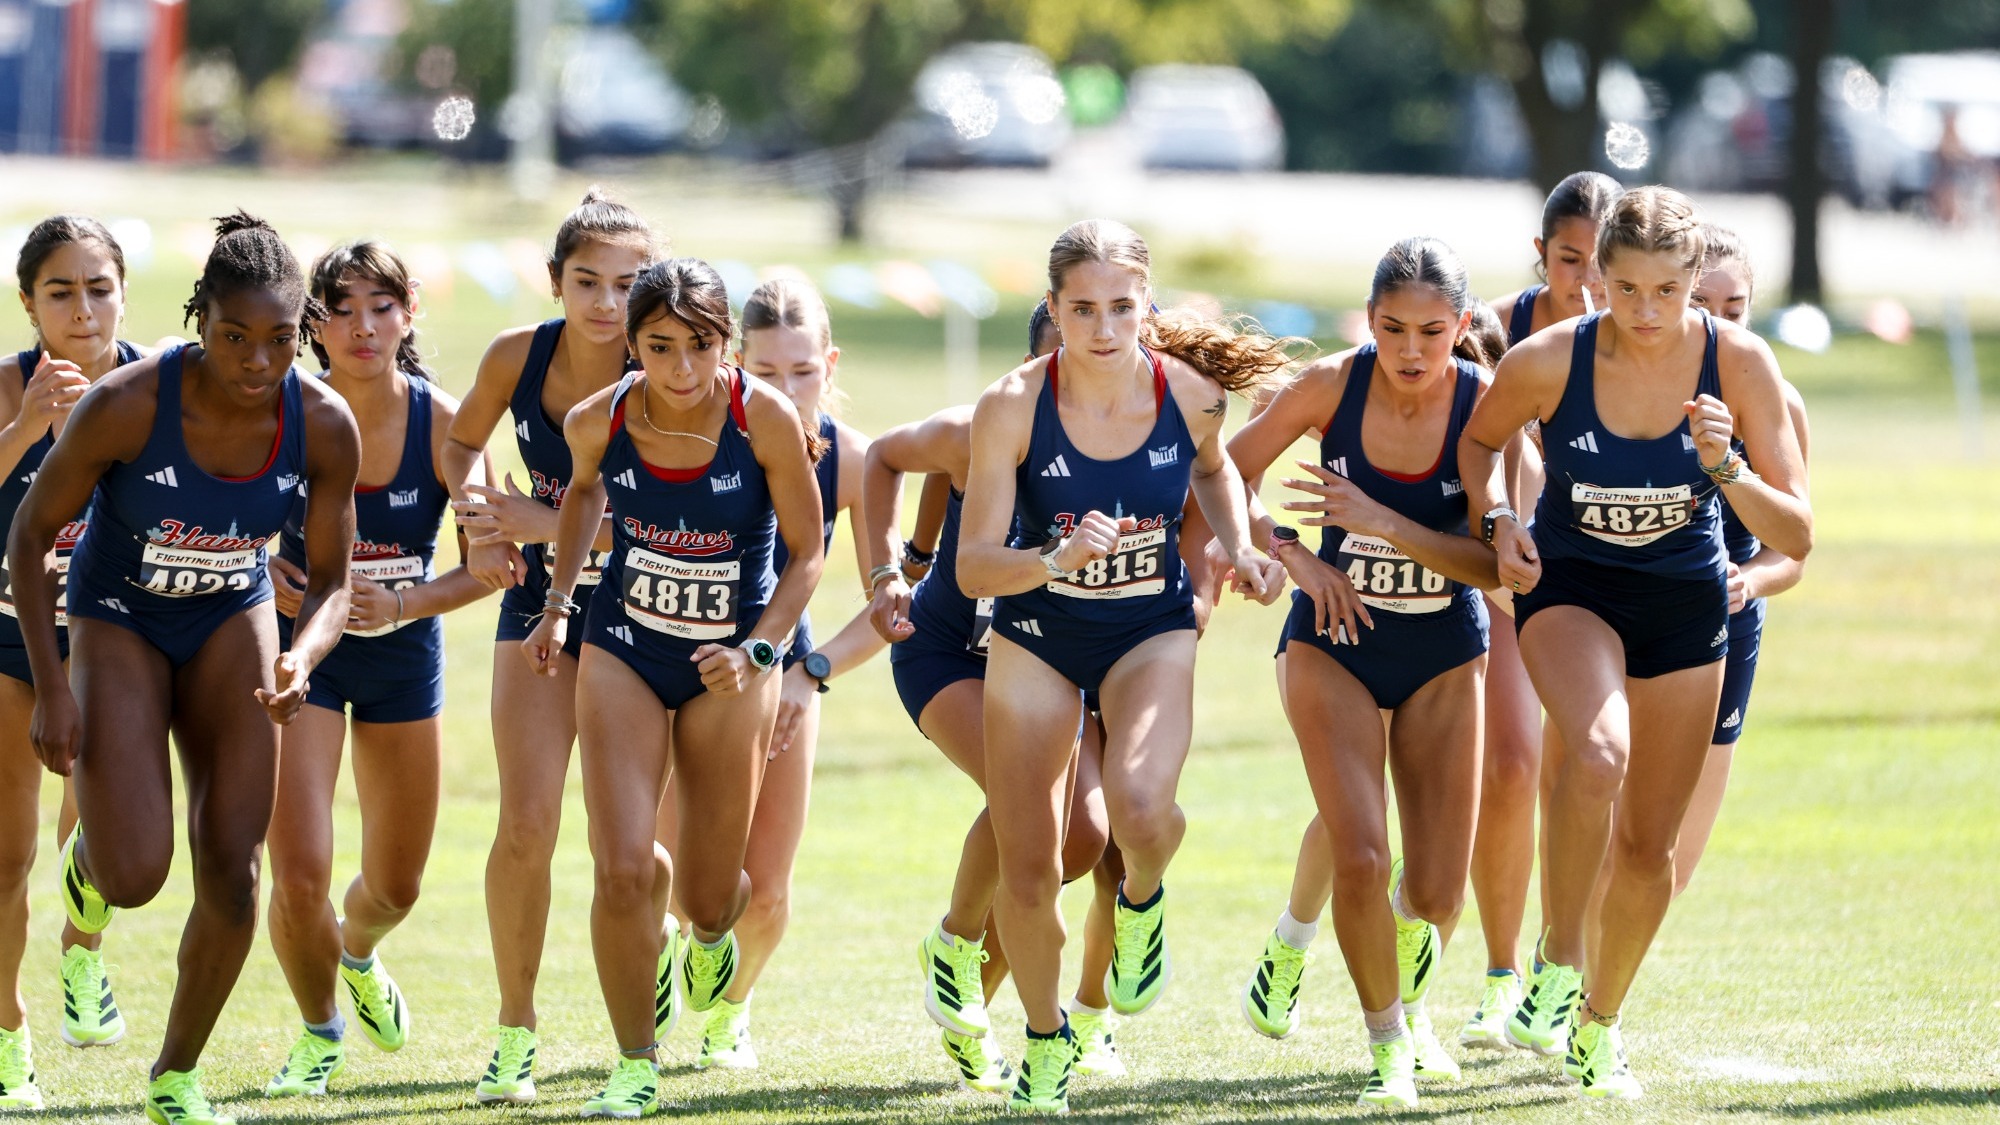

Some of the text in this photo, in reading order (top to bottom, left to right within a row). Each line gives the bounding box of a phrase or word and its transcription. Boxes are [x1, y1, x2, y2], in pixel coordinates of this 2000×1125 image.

[1148, 442, 1178, 467] VALLEY
[710, 470, 742, 493] VALLEY
[388, 488, 418, 507] VALLEY
[1584, 491, 1641, 503] FIGHTING
[1643, 491, 1680, 502] ILLINI
[1581, 502, 1687, 533] 4825
[625, 516, 732, 550] Flames
[1120, 535, 1155, 550] ILLINI
[155, 552, 247, 568] FIGHTING ILLINI
[379, 565, 412, 576] ILLINI
[636, 557, 730, 578] FIGHTING ILLINI
[1346, 558, 1445, 593] 4816
[629, 573, 731, 621] 4813
